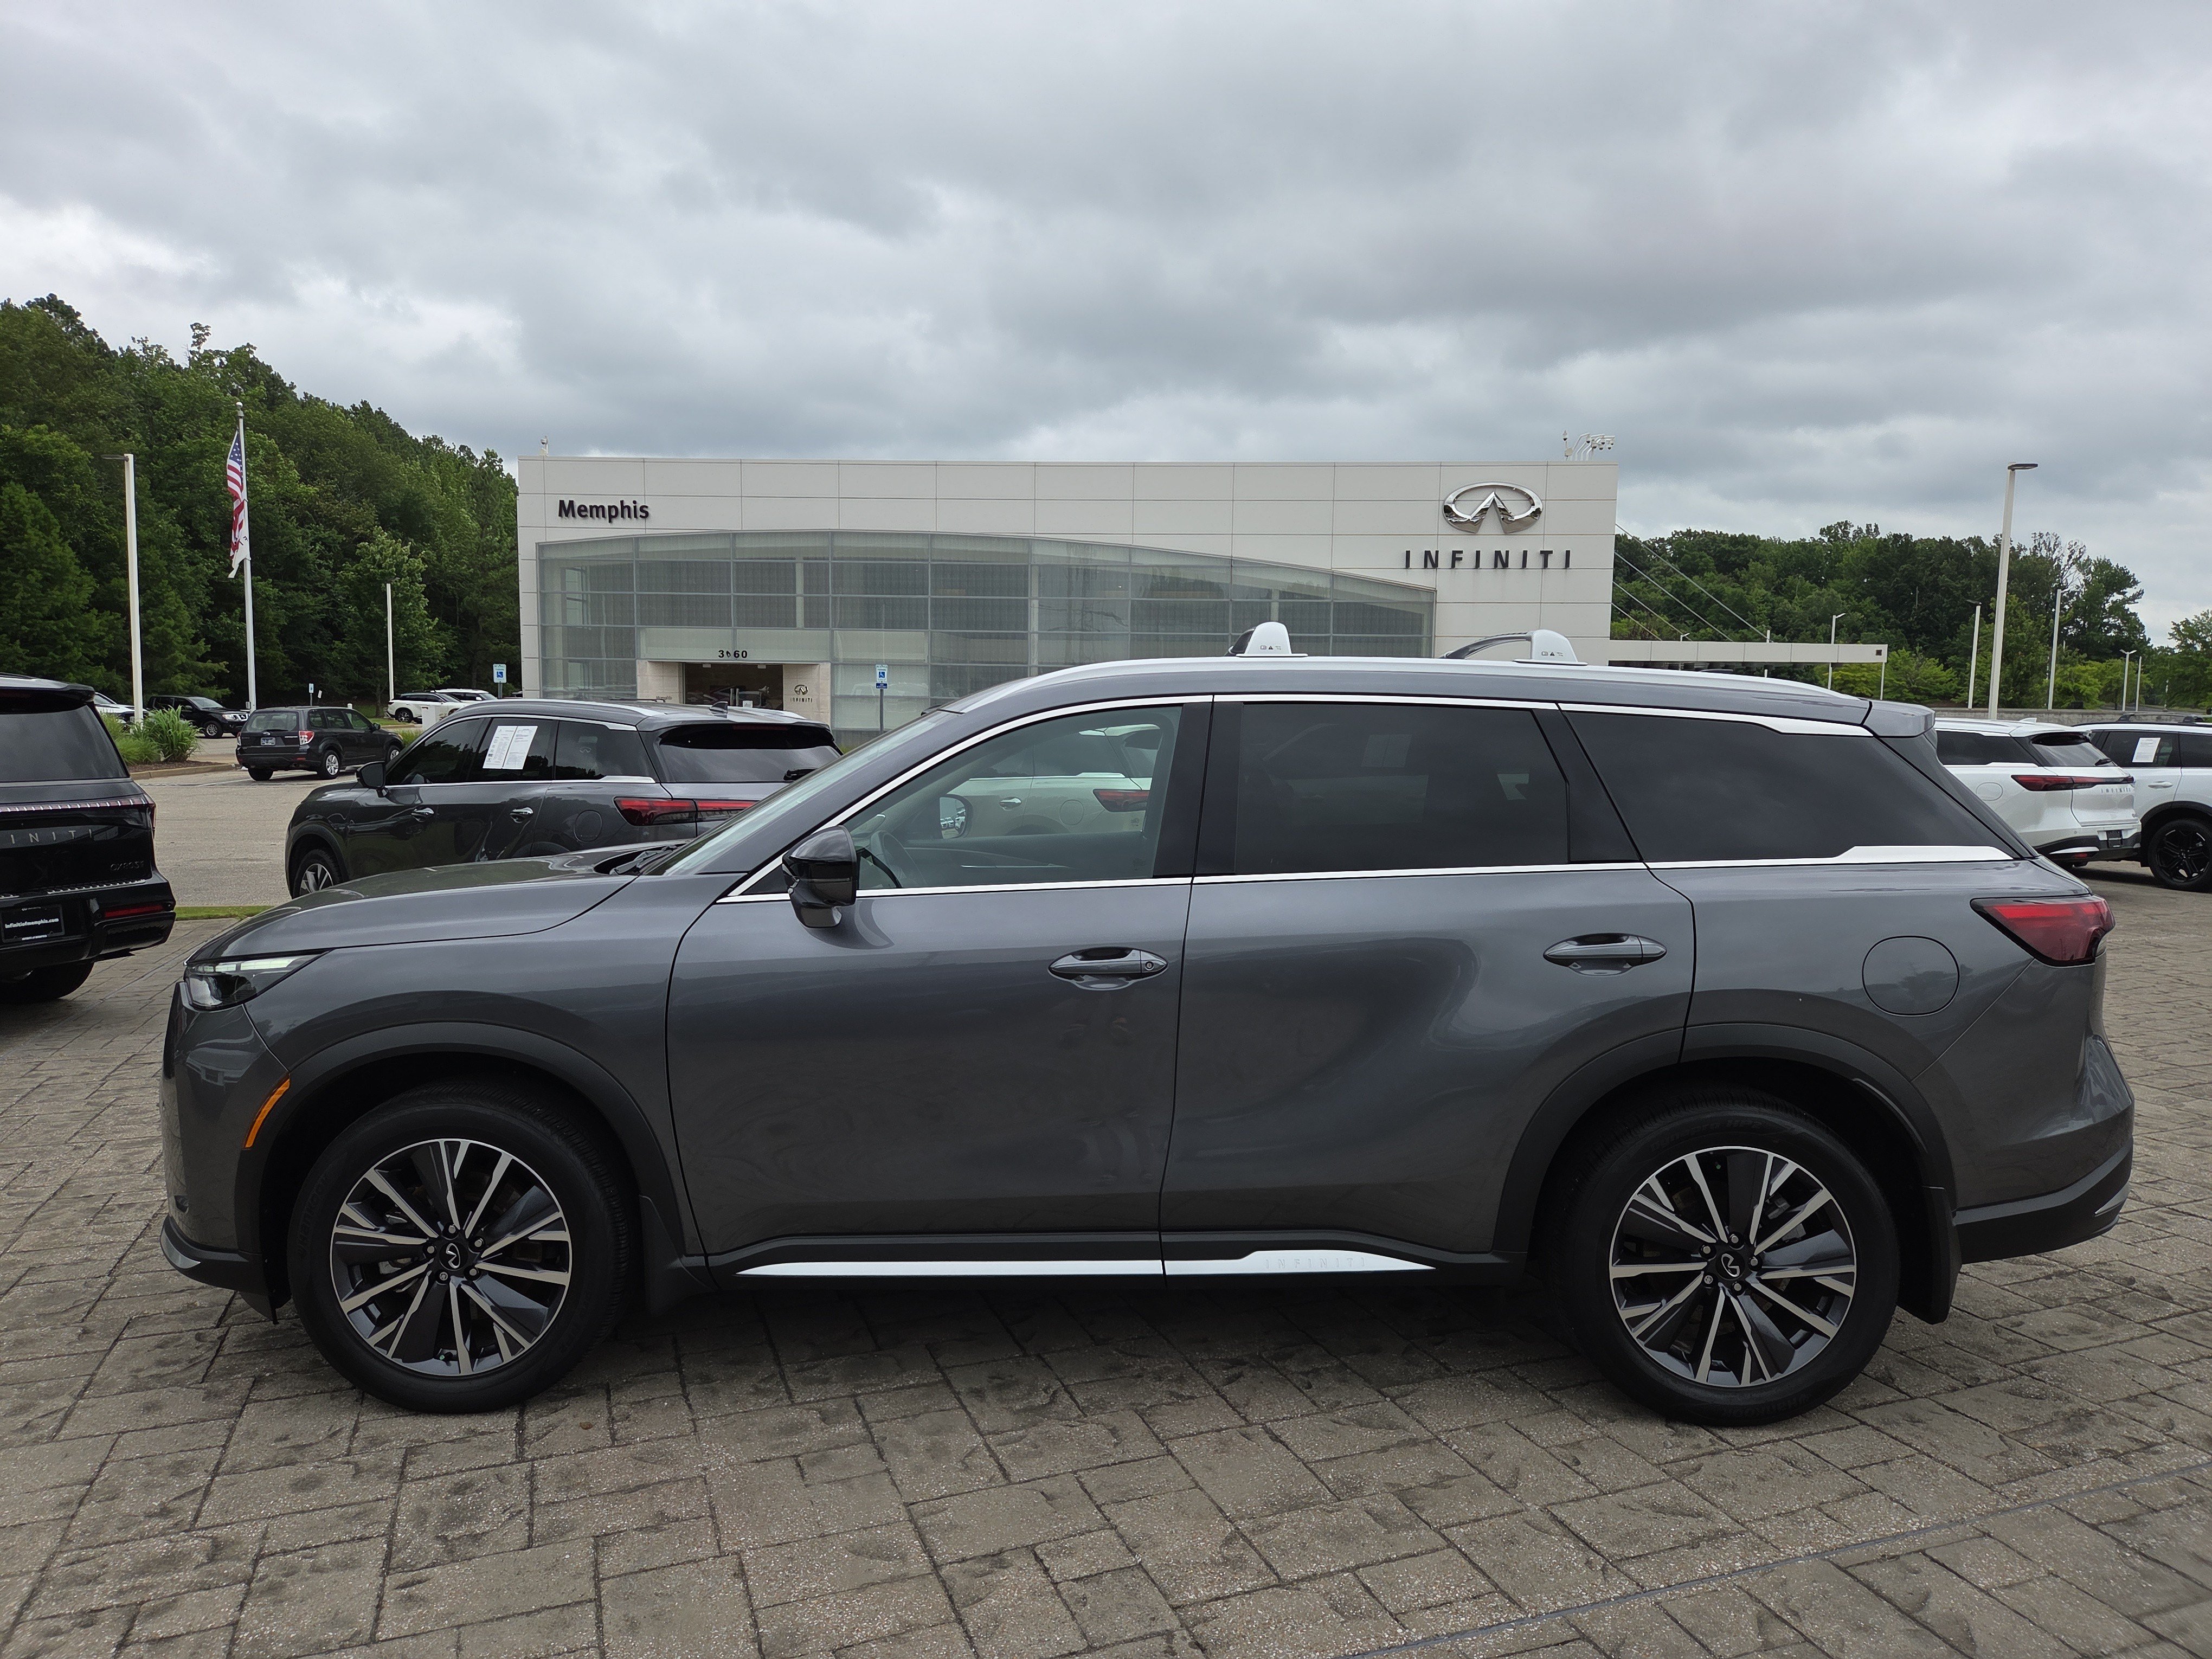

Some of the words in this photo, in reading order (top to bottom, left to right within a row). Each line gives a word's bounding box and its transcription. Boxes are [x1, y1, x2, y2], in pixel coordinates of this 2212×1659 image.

[558, 499, 649, 523] Memphis
[1405, 550, 1571, 569] INFINITI
[1265, 1257, 1366, 1269] INFINITI
